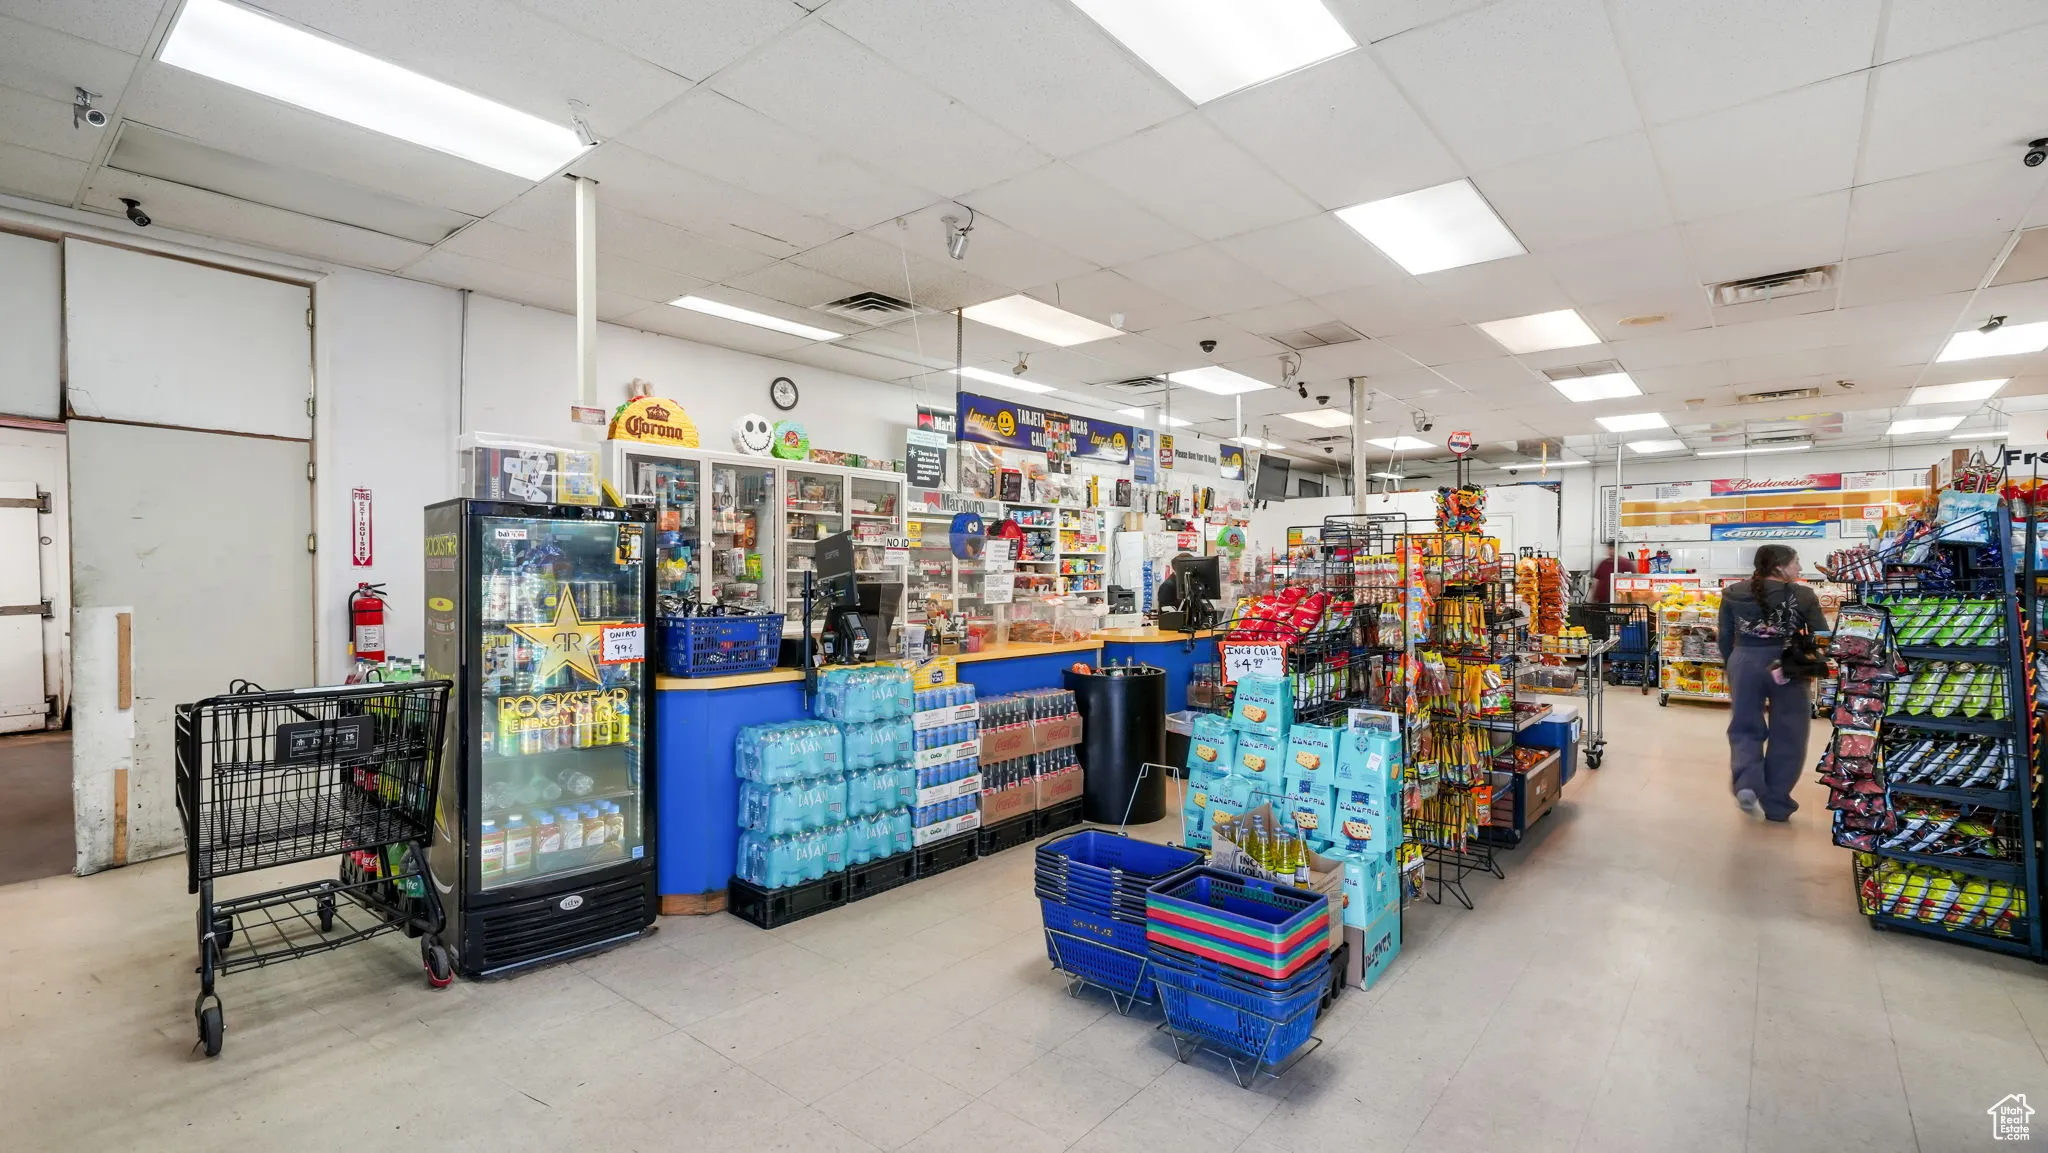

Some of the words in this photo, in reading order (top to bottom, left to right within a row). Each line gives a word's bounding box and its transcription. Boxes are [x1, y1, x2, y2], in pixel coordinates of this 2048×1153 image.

[625, 415, 683, 440] Corona
[1734, 477, 1816, 490] Budweiser
[887, 538, 899, 547] NO
[901, 538, 910, 547] ID
[511, 715, 569, 730] ENERGY
[575, 711, 620, 724] DRINK
